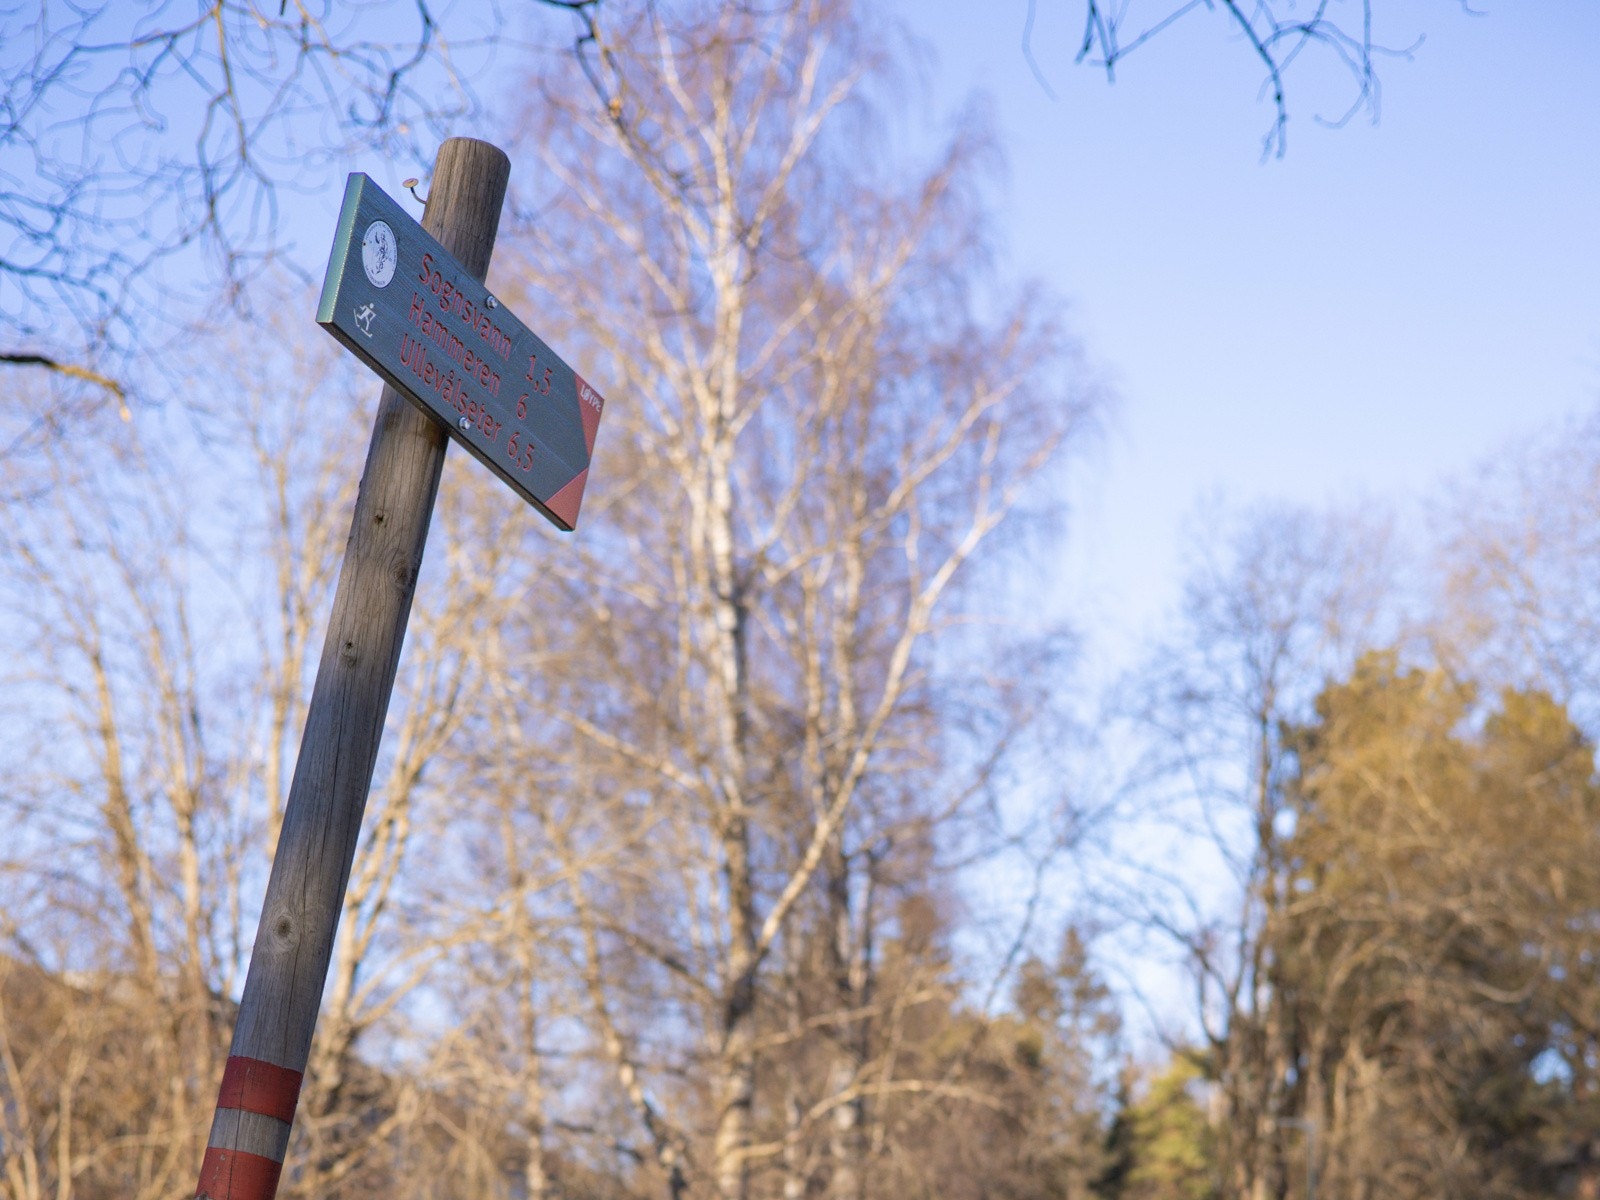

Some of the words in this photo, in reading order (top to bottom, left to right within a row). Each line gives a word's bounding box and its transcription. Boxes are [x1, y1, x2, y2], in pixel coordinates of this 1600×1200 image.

[408, 292, 501, 397] Hammeren
[516, 395, 528, 420] 6
[418, 253, 512, 361] Sognsvann
[526, 354, 553, 395] 1,5
[399, 332, 502, 443] Ullevålseter
[507, 431, 535, 472] 6,5
